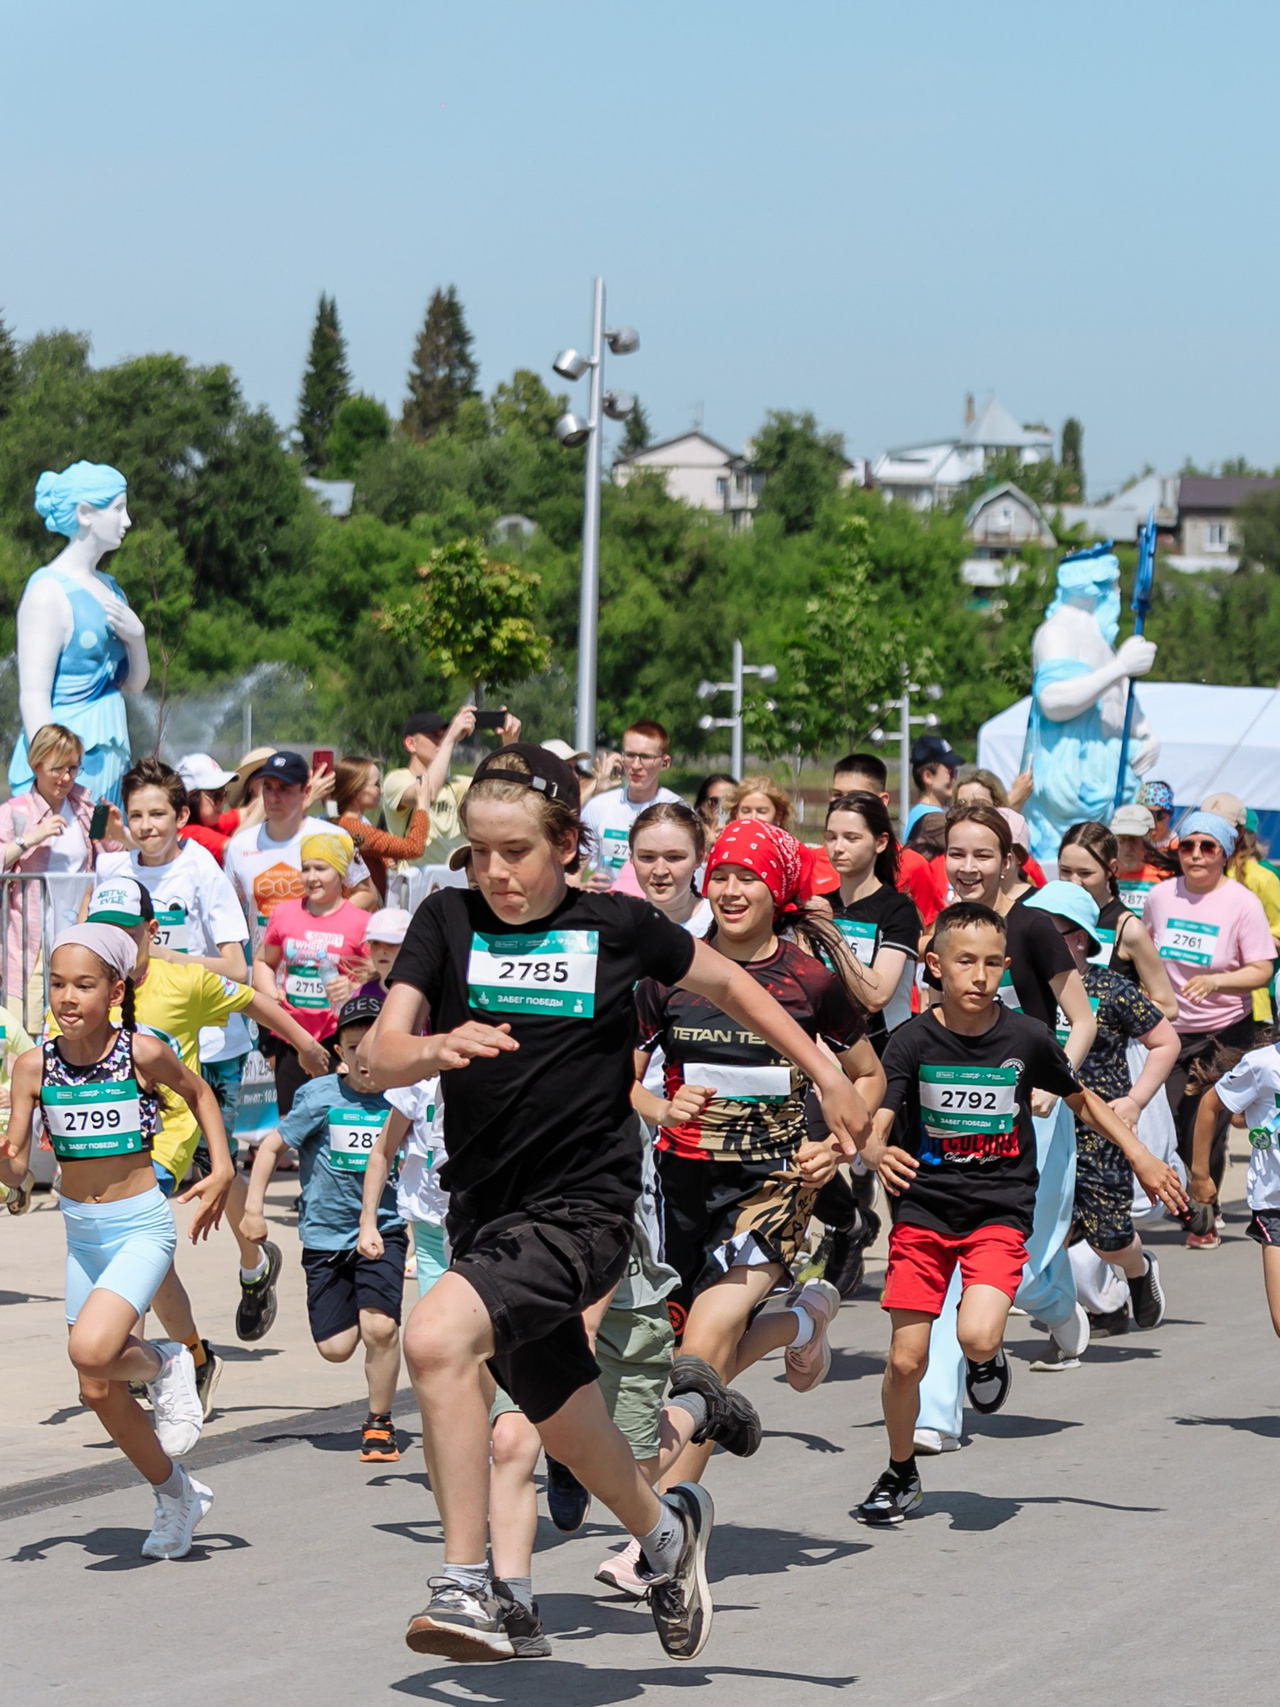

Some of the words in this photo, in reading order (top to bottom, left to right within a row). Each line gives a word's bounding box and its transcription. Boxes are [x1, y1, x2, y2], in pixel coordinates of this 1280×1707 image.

[614, 844, 631, 856] 27
[1173, 934, 1202, 949] 2761
[498, 961, 569, 983] 2785
[296, 981, 324, 994] 2715
[497, 995, 525, 1004] ЗАБЕГ
[526, 997, 564, 1007] ПОБЕДЫ
[673, 1026, 732, 1043] TETAN
[940, 1090, 997, 1110] 2792
[64, 1109, 121, 1131] 2799
[940, 1117, 961, 1126] ЗАБЕГ
[962, 1119, 991, 1128] ПОБЕДЫ
[348, 1131, 380, 1149] 28
